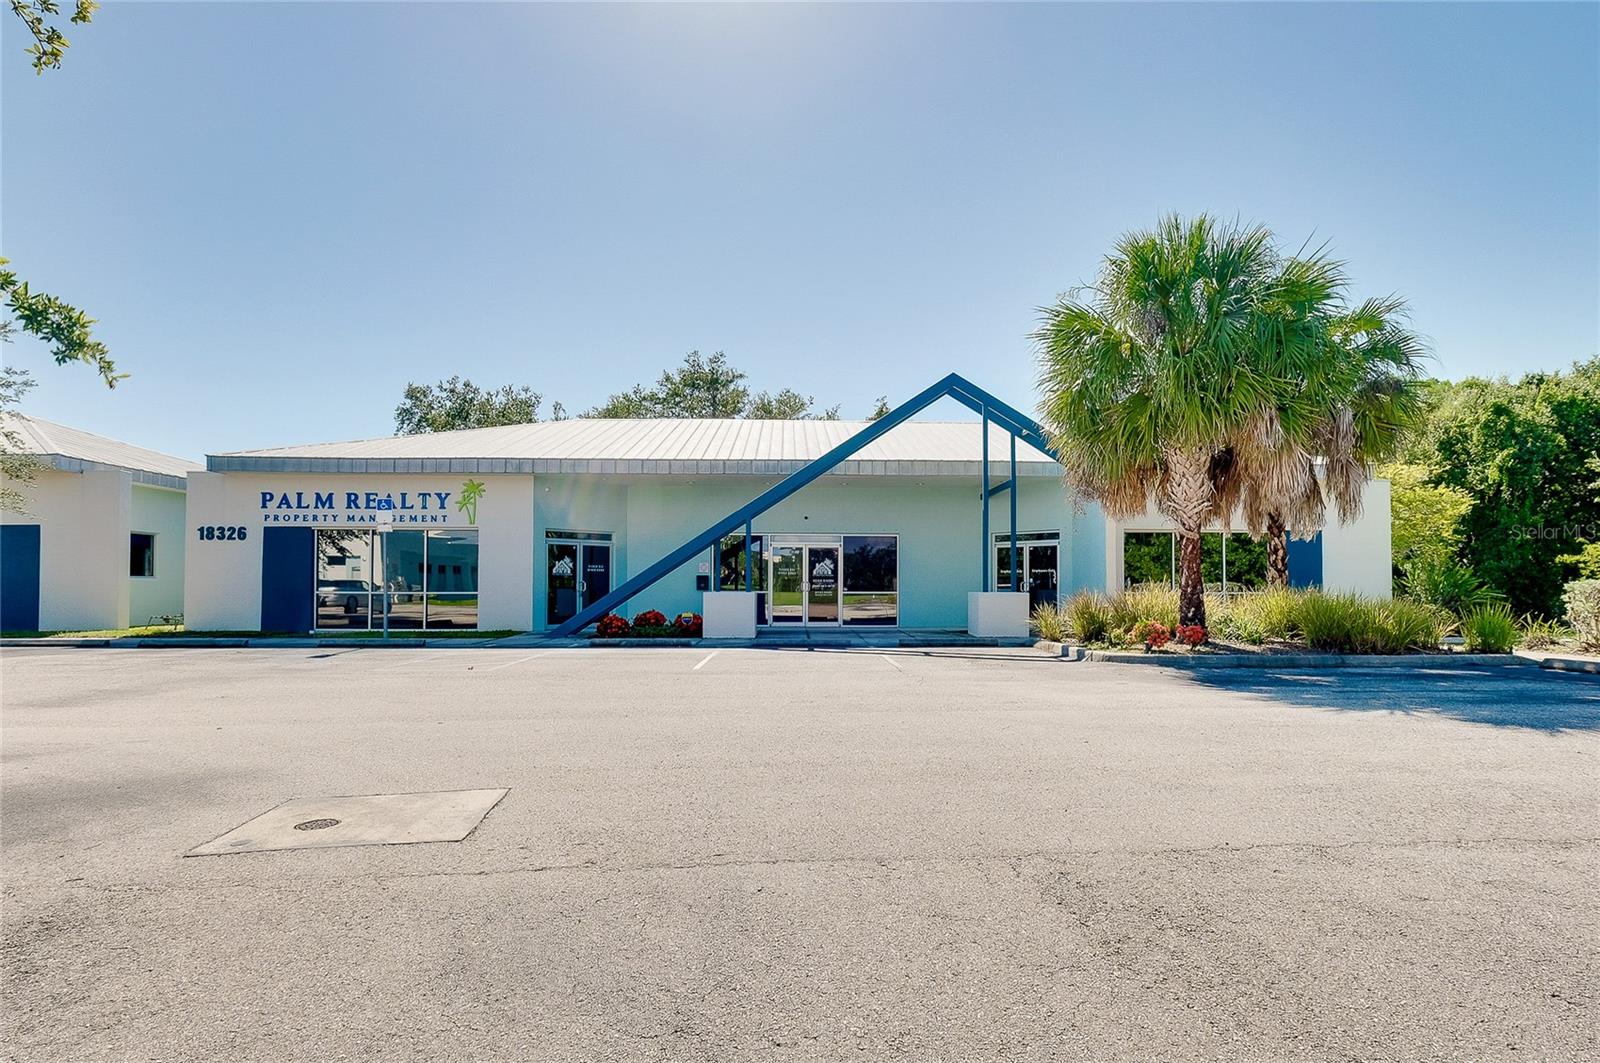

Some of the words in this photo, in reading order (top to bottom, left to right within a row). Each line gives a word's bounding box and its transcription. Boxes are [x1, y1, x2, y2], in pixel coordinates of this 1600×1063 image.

[261, 492, 335, 510] PALM
[264, 514, 339, 523] PROPERTY
[346, 514, 448, 523] MANGEMENT
[197, 526, 247, 541] 18326
